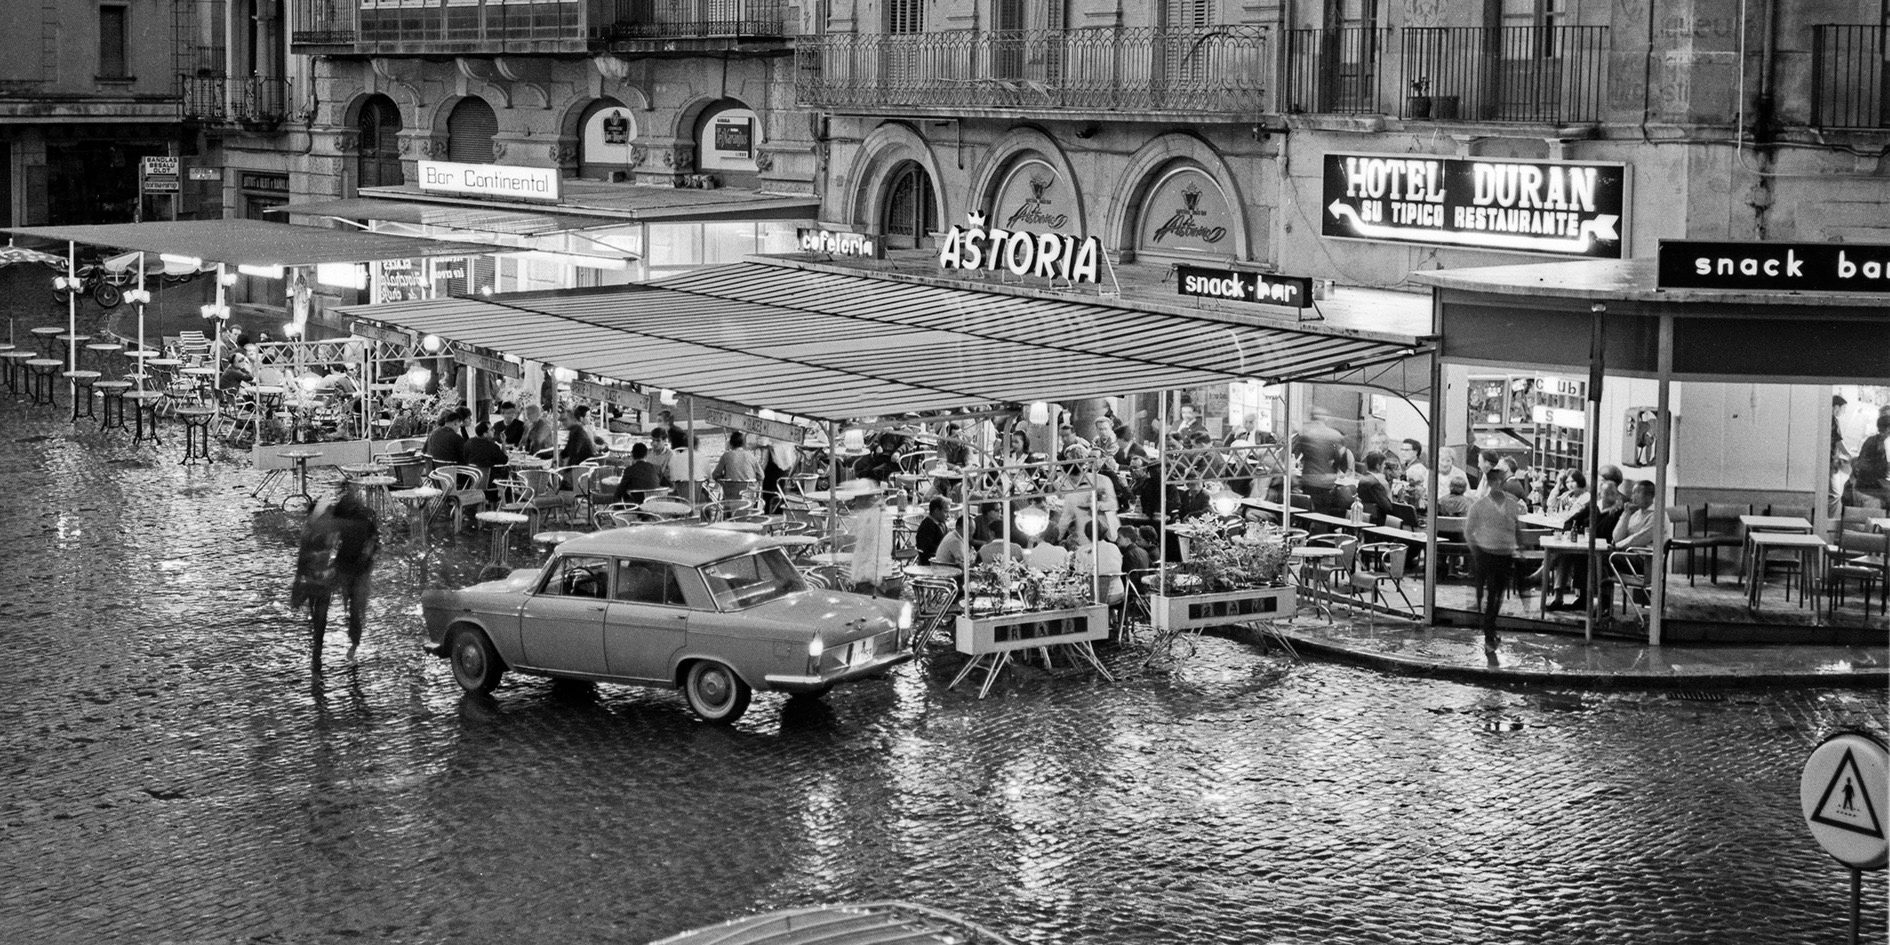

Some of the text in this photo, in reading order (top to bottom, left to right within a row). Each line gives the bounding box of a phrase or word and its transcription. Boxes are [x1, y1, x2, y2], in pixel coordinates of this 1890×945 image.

[426, 166, 549, 193] Bar Continental
[1346, 157, 1598, 212] HOTEL DURAN
[1361, 200, 1579, 237] SU TIPICO RESTAURANTE
[939, 225, 1101, 284] ASTORIA
[1695, 249, 1803, 277] snack
